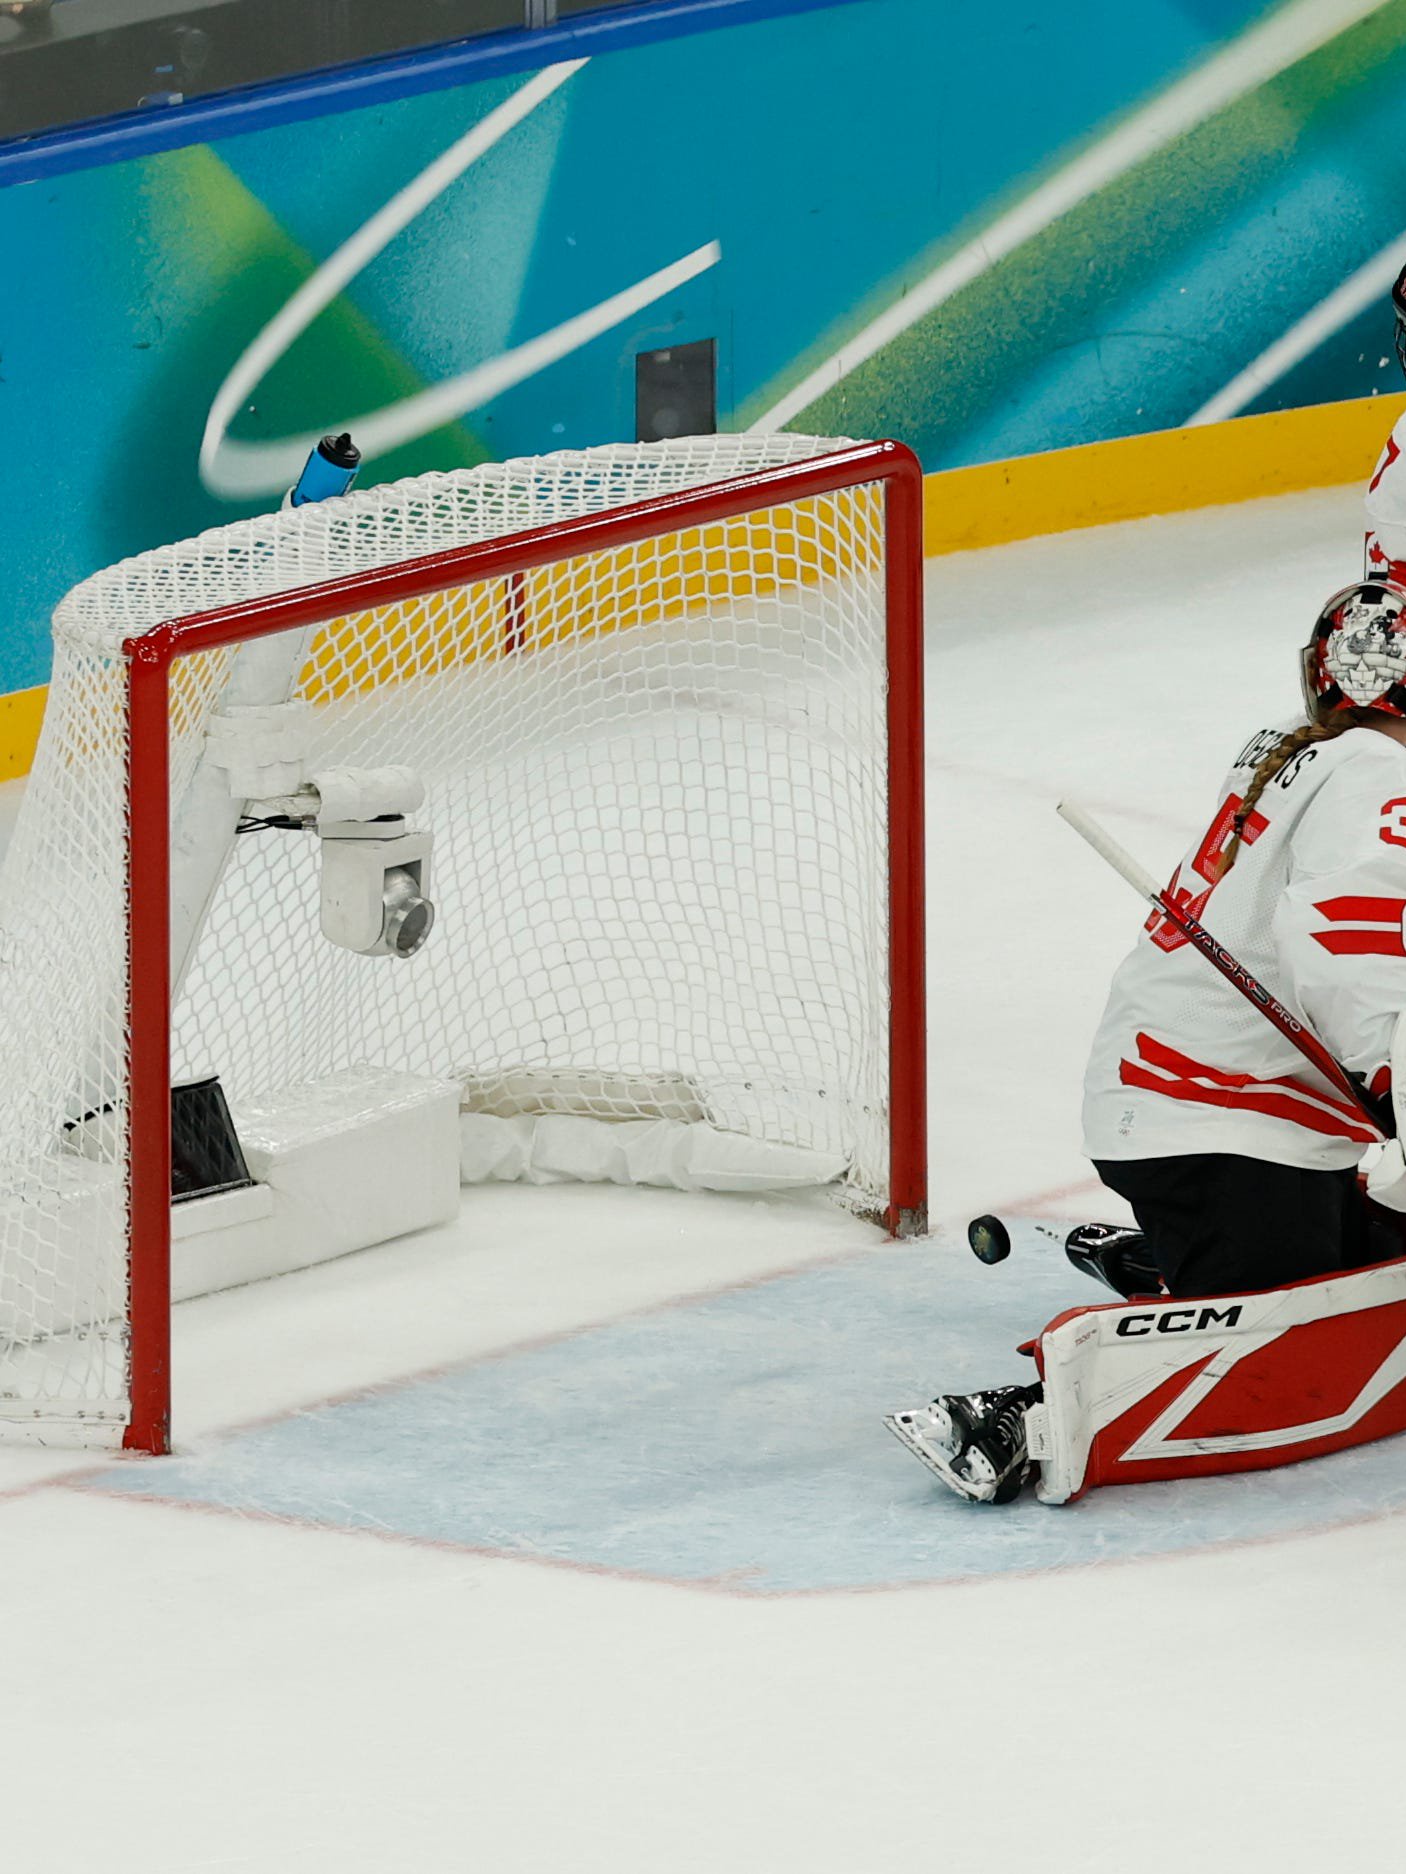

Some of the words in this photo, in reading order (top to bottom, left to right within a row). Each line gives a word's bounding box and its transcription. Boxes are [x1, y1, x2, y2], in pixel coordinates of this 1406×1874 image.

[1182, 910, 1270, 1006] TACKS
[1270, 1002, 1302, 1033] PRO
[1115, 1305, 1244, 1338] CCM
